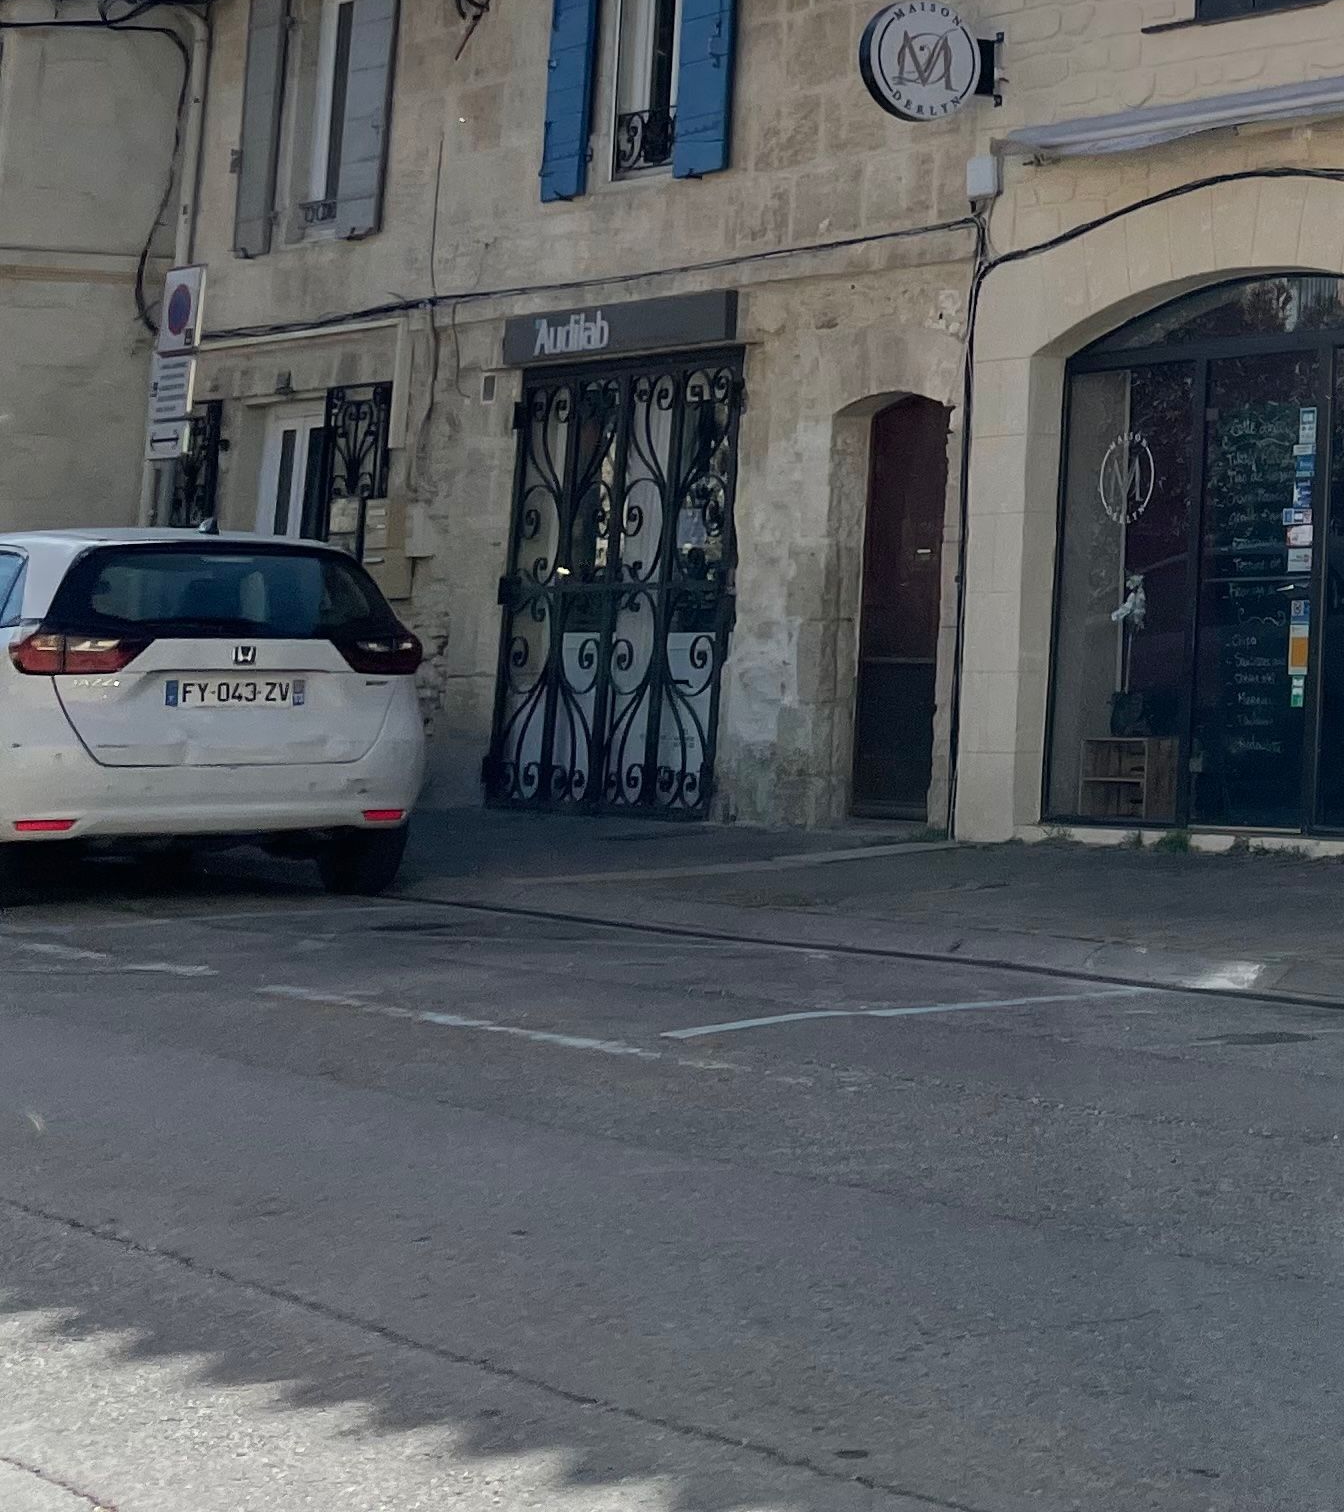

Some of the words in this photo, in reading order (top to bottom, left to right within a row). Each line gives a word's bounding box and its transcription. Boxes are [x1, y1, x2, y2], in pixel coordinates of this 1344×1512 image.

[894, 2, 962, 27] MAISON
[892, 90, 962, 116] DERLYN
[533, 309, 609, 357] Audilab
[1110, 431, 1147, 450] MAISON
[182, 682, 290, 703] FY-043-ZV
